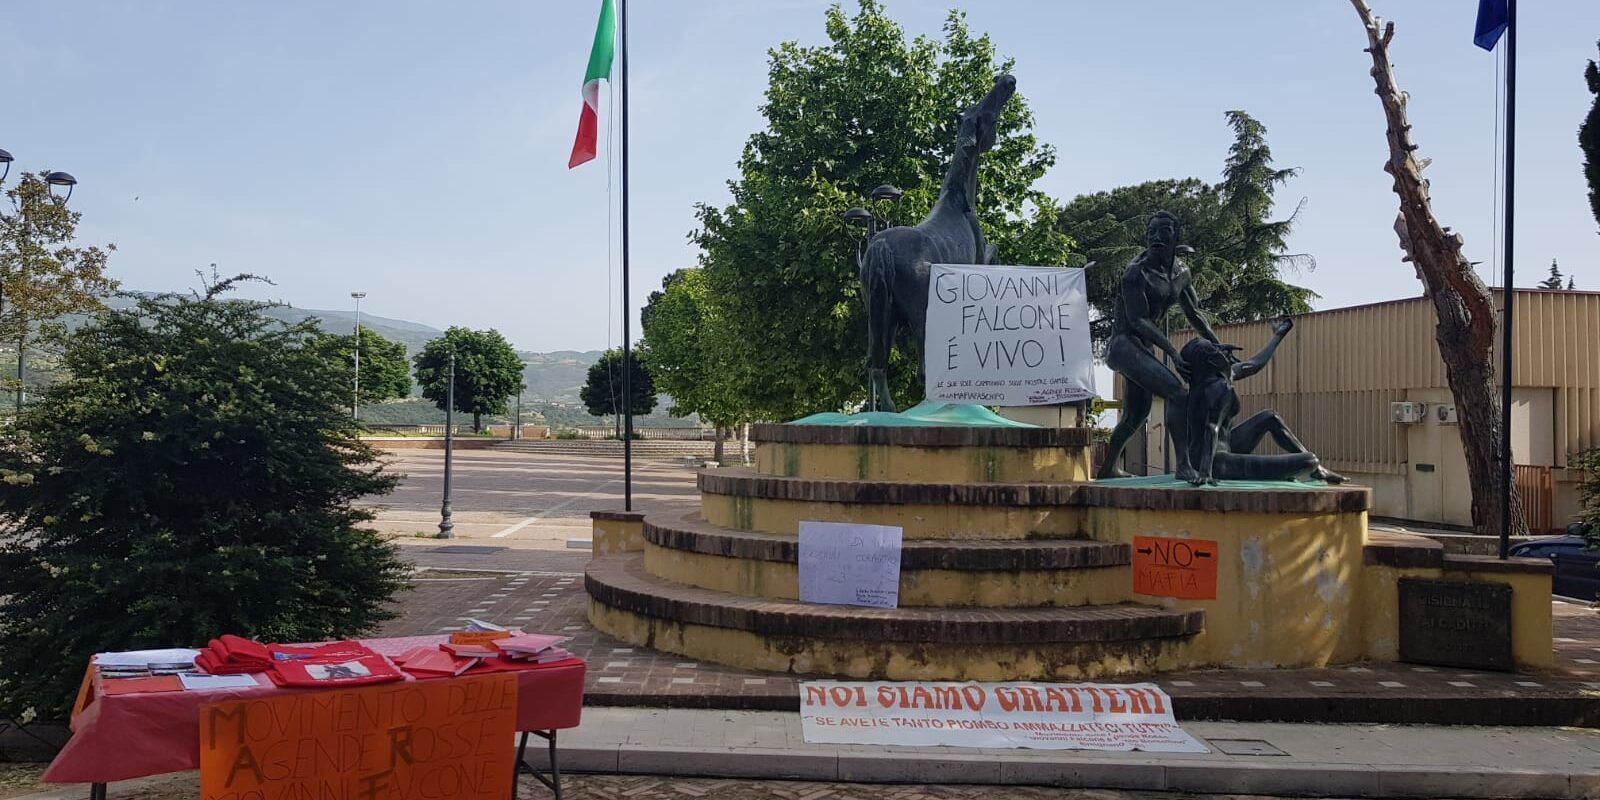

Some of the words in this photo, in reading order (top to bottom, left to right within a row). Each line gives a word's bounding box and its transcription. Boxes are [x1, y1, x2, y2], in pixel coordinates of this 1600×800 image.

[935, 272, 1059, 304] GIOVANNI
[961, 303, 1072, 335] FALCONE
[973, 339, 1045, 370] VIVO
[1154, 540, 1193, 568] NO
[1138, 570, 1199, 591] MAFIA
[208, 685, 427, 750] MOVIMENTO
[448, 679, 514, 716] DELLE
[805, 685, 867, 708] NOI
[876, 685, 987, 712] SIAMO
[994, 686, 1166, 715] GRATTERI
[891, 717, 944, 729] TANTO
[948, 718, 1009, 731] PIOMBO
[224, 732, 376, 788] AGENDE
[387, 716, 497, 768] ROSSE
[359, 761, 497, 800] FALCONE
